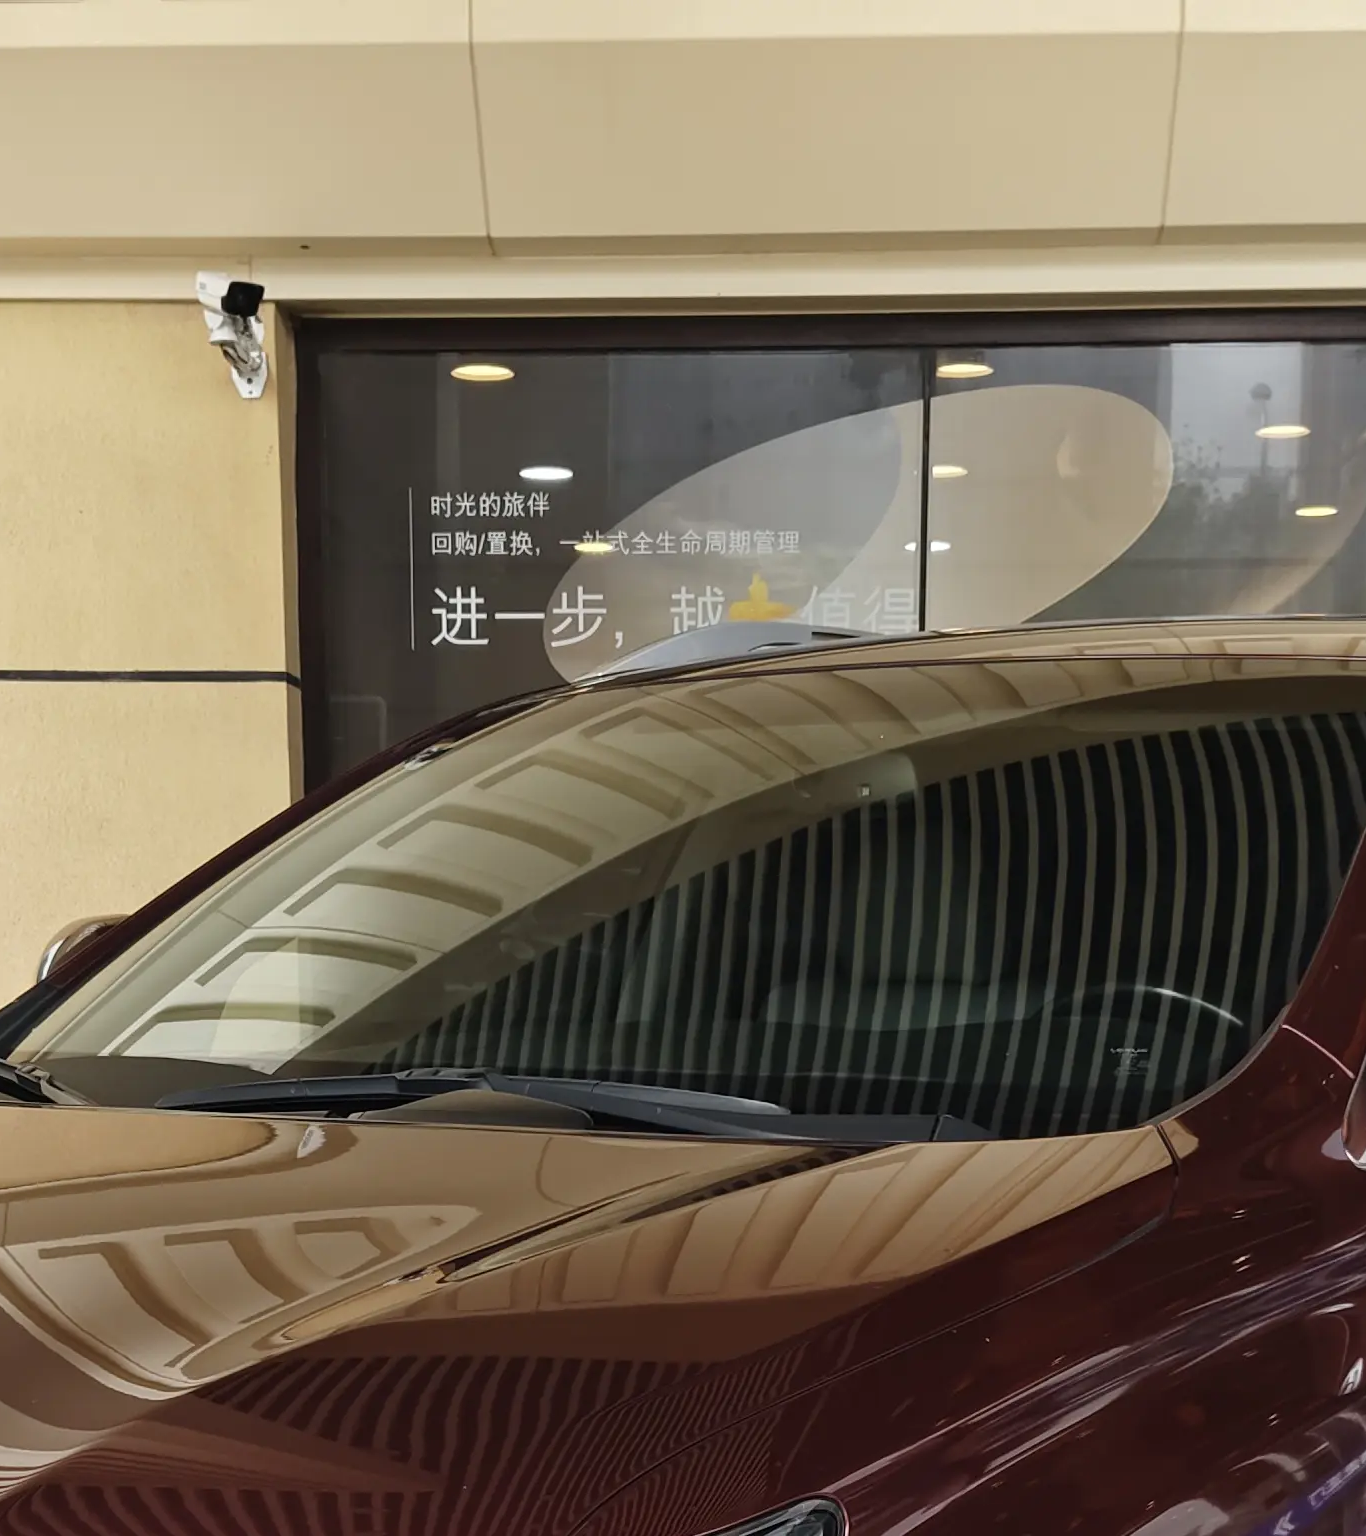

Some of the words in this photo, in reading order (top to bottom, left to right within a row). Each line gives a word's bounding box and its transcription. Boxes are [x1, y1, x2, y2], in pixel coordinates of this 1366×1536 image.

[430, 491, 550, 518] 时光的旅伴
